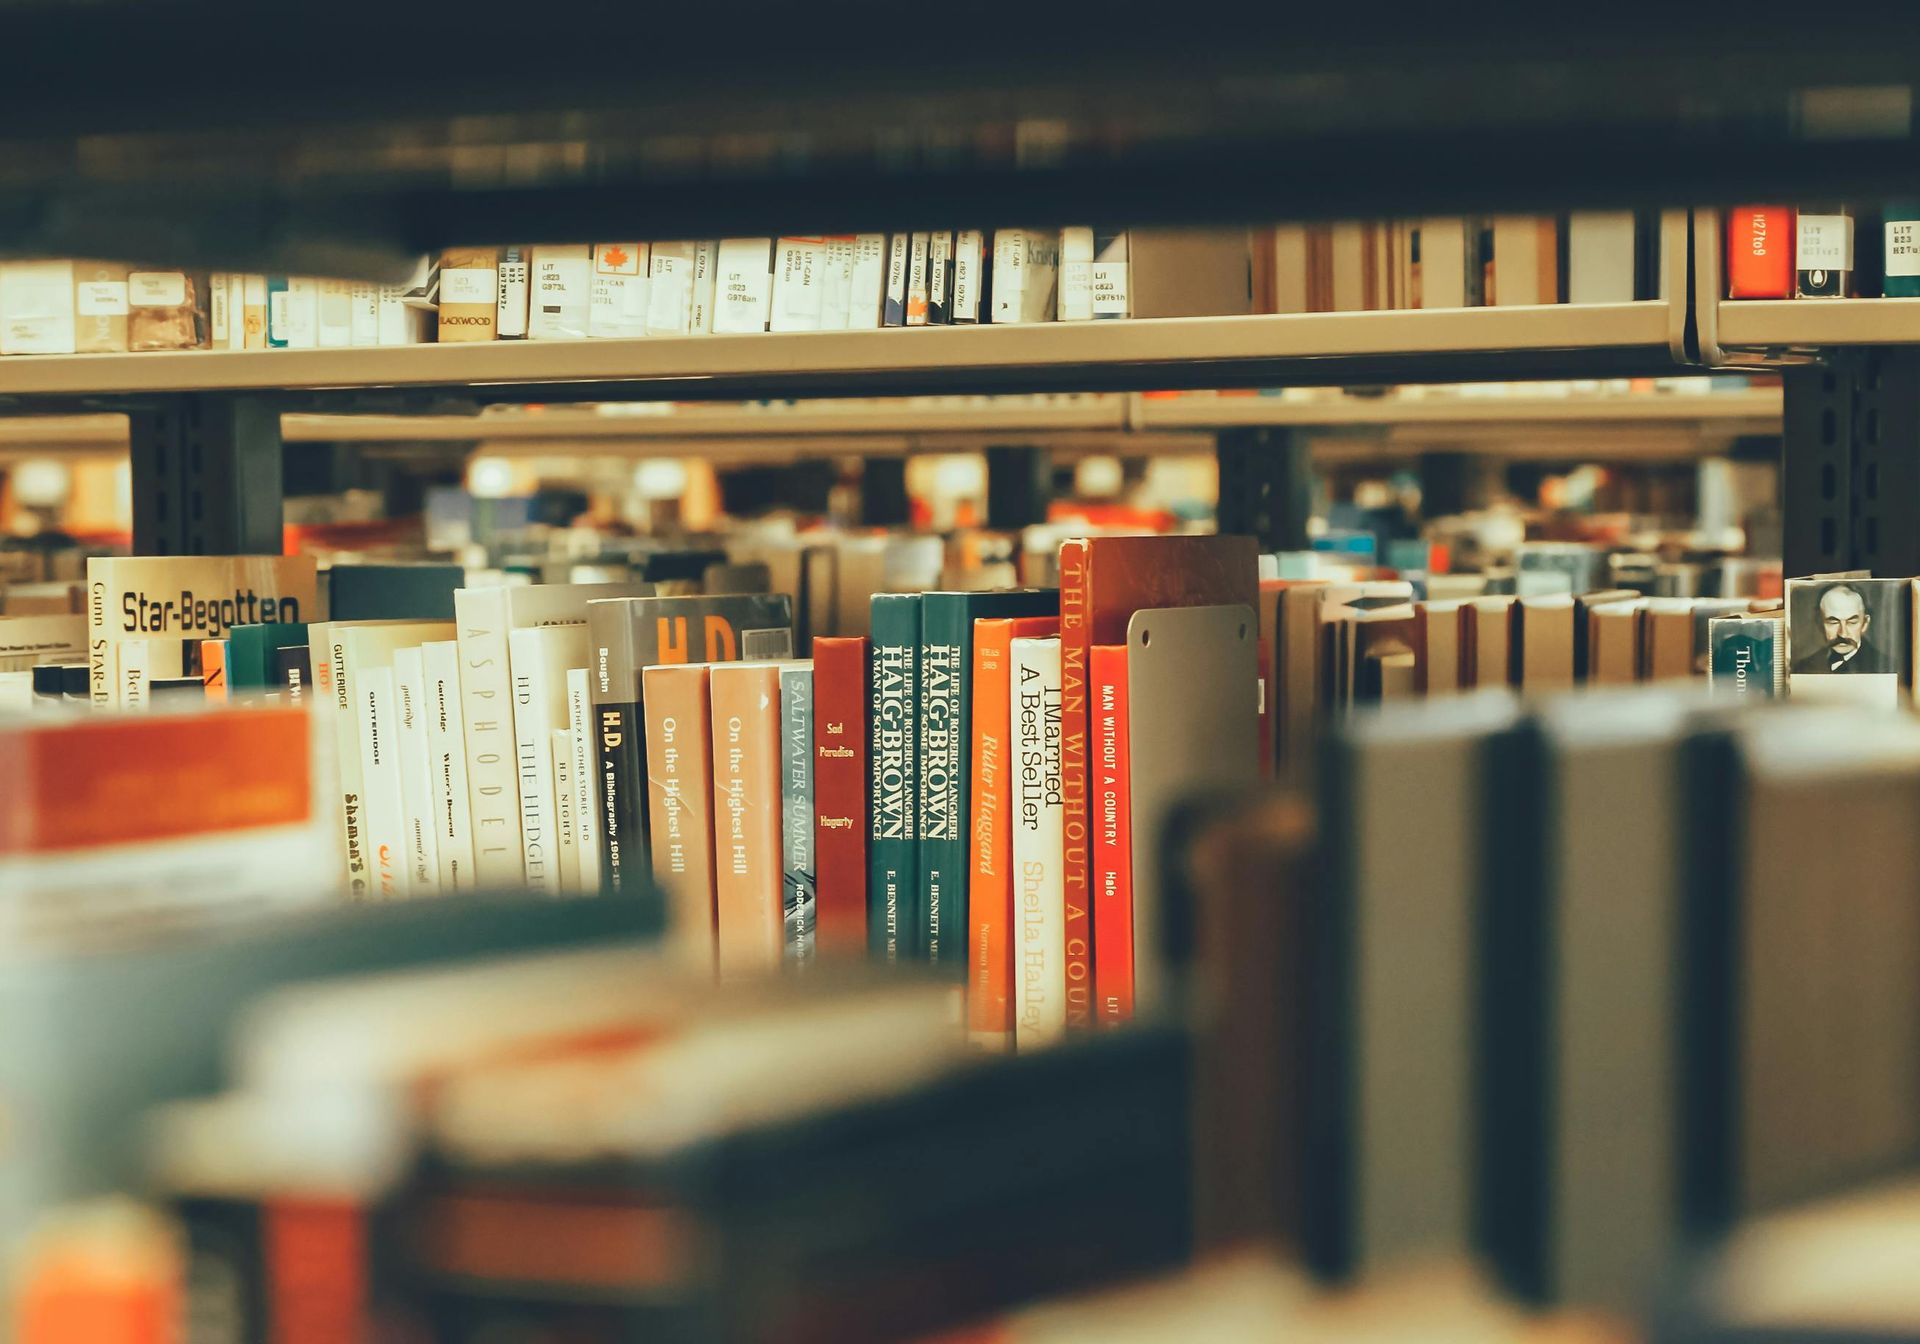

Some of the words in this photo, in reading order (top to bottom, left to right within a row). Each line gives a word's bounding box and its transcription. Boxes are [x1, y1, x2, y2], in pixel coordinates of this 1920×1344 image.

[1753, 214, 1766, 256] H27to9
[1893, 226, 1912, 234] LIT
[517, 267, 525, 283] LIT
[542, 273, 560, 281] c823
[665, 259, 673, 273] LIT
[728, 273, 741, 281] LIT
[803, 251, 813, 286] LIT-CAN
[1095, 272, 1107, 280] LIT
[542, 283, 567, 291] G973L
[727, 293, 757, 303] G976an
[728, 284, 746, 292] c823
[1095, 282, 1114, 290] c823
[93, 582, 105, 627] Gunn
[123, 589, 300, 637] Star-Begotten
[1064, 563, 1083, 630] THE
[873, 646, 881, 656] A
[903, 646, 913, 671] THE
[921, 645, 930, 654] A
[950, 645, 960, 669] THE
[333, 644, 348, 710] GUTTERIDGE
[599, 647, 609, 693] Boughn
[873, 658, 881, 690] MAN
[903, 672, 913, 697] LIFE
[920, 658, 930, 689] MAN
[950, 671, 960, 696] LIFE
[1020, 663, 1040, 686] A
[1064, 646, 1084, 714] MAN
[873, 693, 881, 712] OF
[903, 699, 913, 716] OF
[920, 691, 929, 711] OF
[950, 698, 960, 715] OF
[1044, 685, 1062, 697] I
[1102, 685, 1115, 711] MAN
[369, 691, 380, 765] GUTTERIDGE
[573, 690, 582, 734] NARTHEX
[826, 723, 843, 734] Sad
[1021, 691, 1041, 747] Best
[438, 679, 447, 733] Gutteridge
[443, 753, 453, 796] Winter's
[602, 711, 622, 753] H.D.
[662, 717, 677, 743] On
[728, 716, 742, 743] On
[790, 680, 807, 790] SALTWATER
[873, 714, 881, 751] SOME
[882, 645, 904, 841] HAIG-BROWN
[920, 713, 929, 750] SOME
[928, 644, 951, 840] HAIG-BROWN
[1103, 715, 1116, 770] WITHOUT
[520, 738, 537, 785] THE
[577, 745, 586, 777] OTHER
[605, 760, 615, 769] A
[664, 748, 679, 773] the
[728, 748, 744, 773] the
[819, 746, 854, 758] Paradise
[903, 718, 913, 780] RODERICK
[949, 717, 959, 780] RODERICK
[981, 732, 999, 788] Rider
[1044, 703, 1064, 808] Married
[1021, 751, 1043, 831] Seller
[1103, 775, 1116, 785] A
[579, 779, 588, 816] STORIES
[605, 772, 618, 837] Bibliography
[663, 778, 681, 839] Highest
[727, 779, 745, 839] Highest
[873, 755, 882, 841] IMPORTANCE
[919, 754, 928, 841] IMPORTANCE
[1064, 731, 1086, 889] WITHOUT
[561, 794, 572, 846] NIGHTS
[791, 793, 808, 872] SUMMER
[820, 815, 854, 830] Hogarty
[975, 790, 997, 876] Haggard
[1104, 791, 1117, 847] COUNTRY
[670, 843, 685, 873] Hill
[733, 845, 747, 874] Hill
[886, 870, 896, 880] E.
[930, 870, 940, 881] E.
[1105, 871, 1118, 897] Hale
[796, 883, 805, 932] RODERICK
[886, 883, 896, 935] BENNETT
[930, 884, 940, 936] BENNETT
[1023, 860, 1044, 943] Sheila
[1067, 903, 1086, 923] A
[979, 923, 990, 966] Norman
[1022, 949, 1046, 1033] Hailey
[1107, 997, 1119, 1015] LIT
